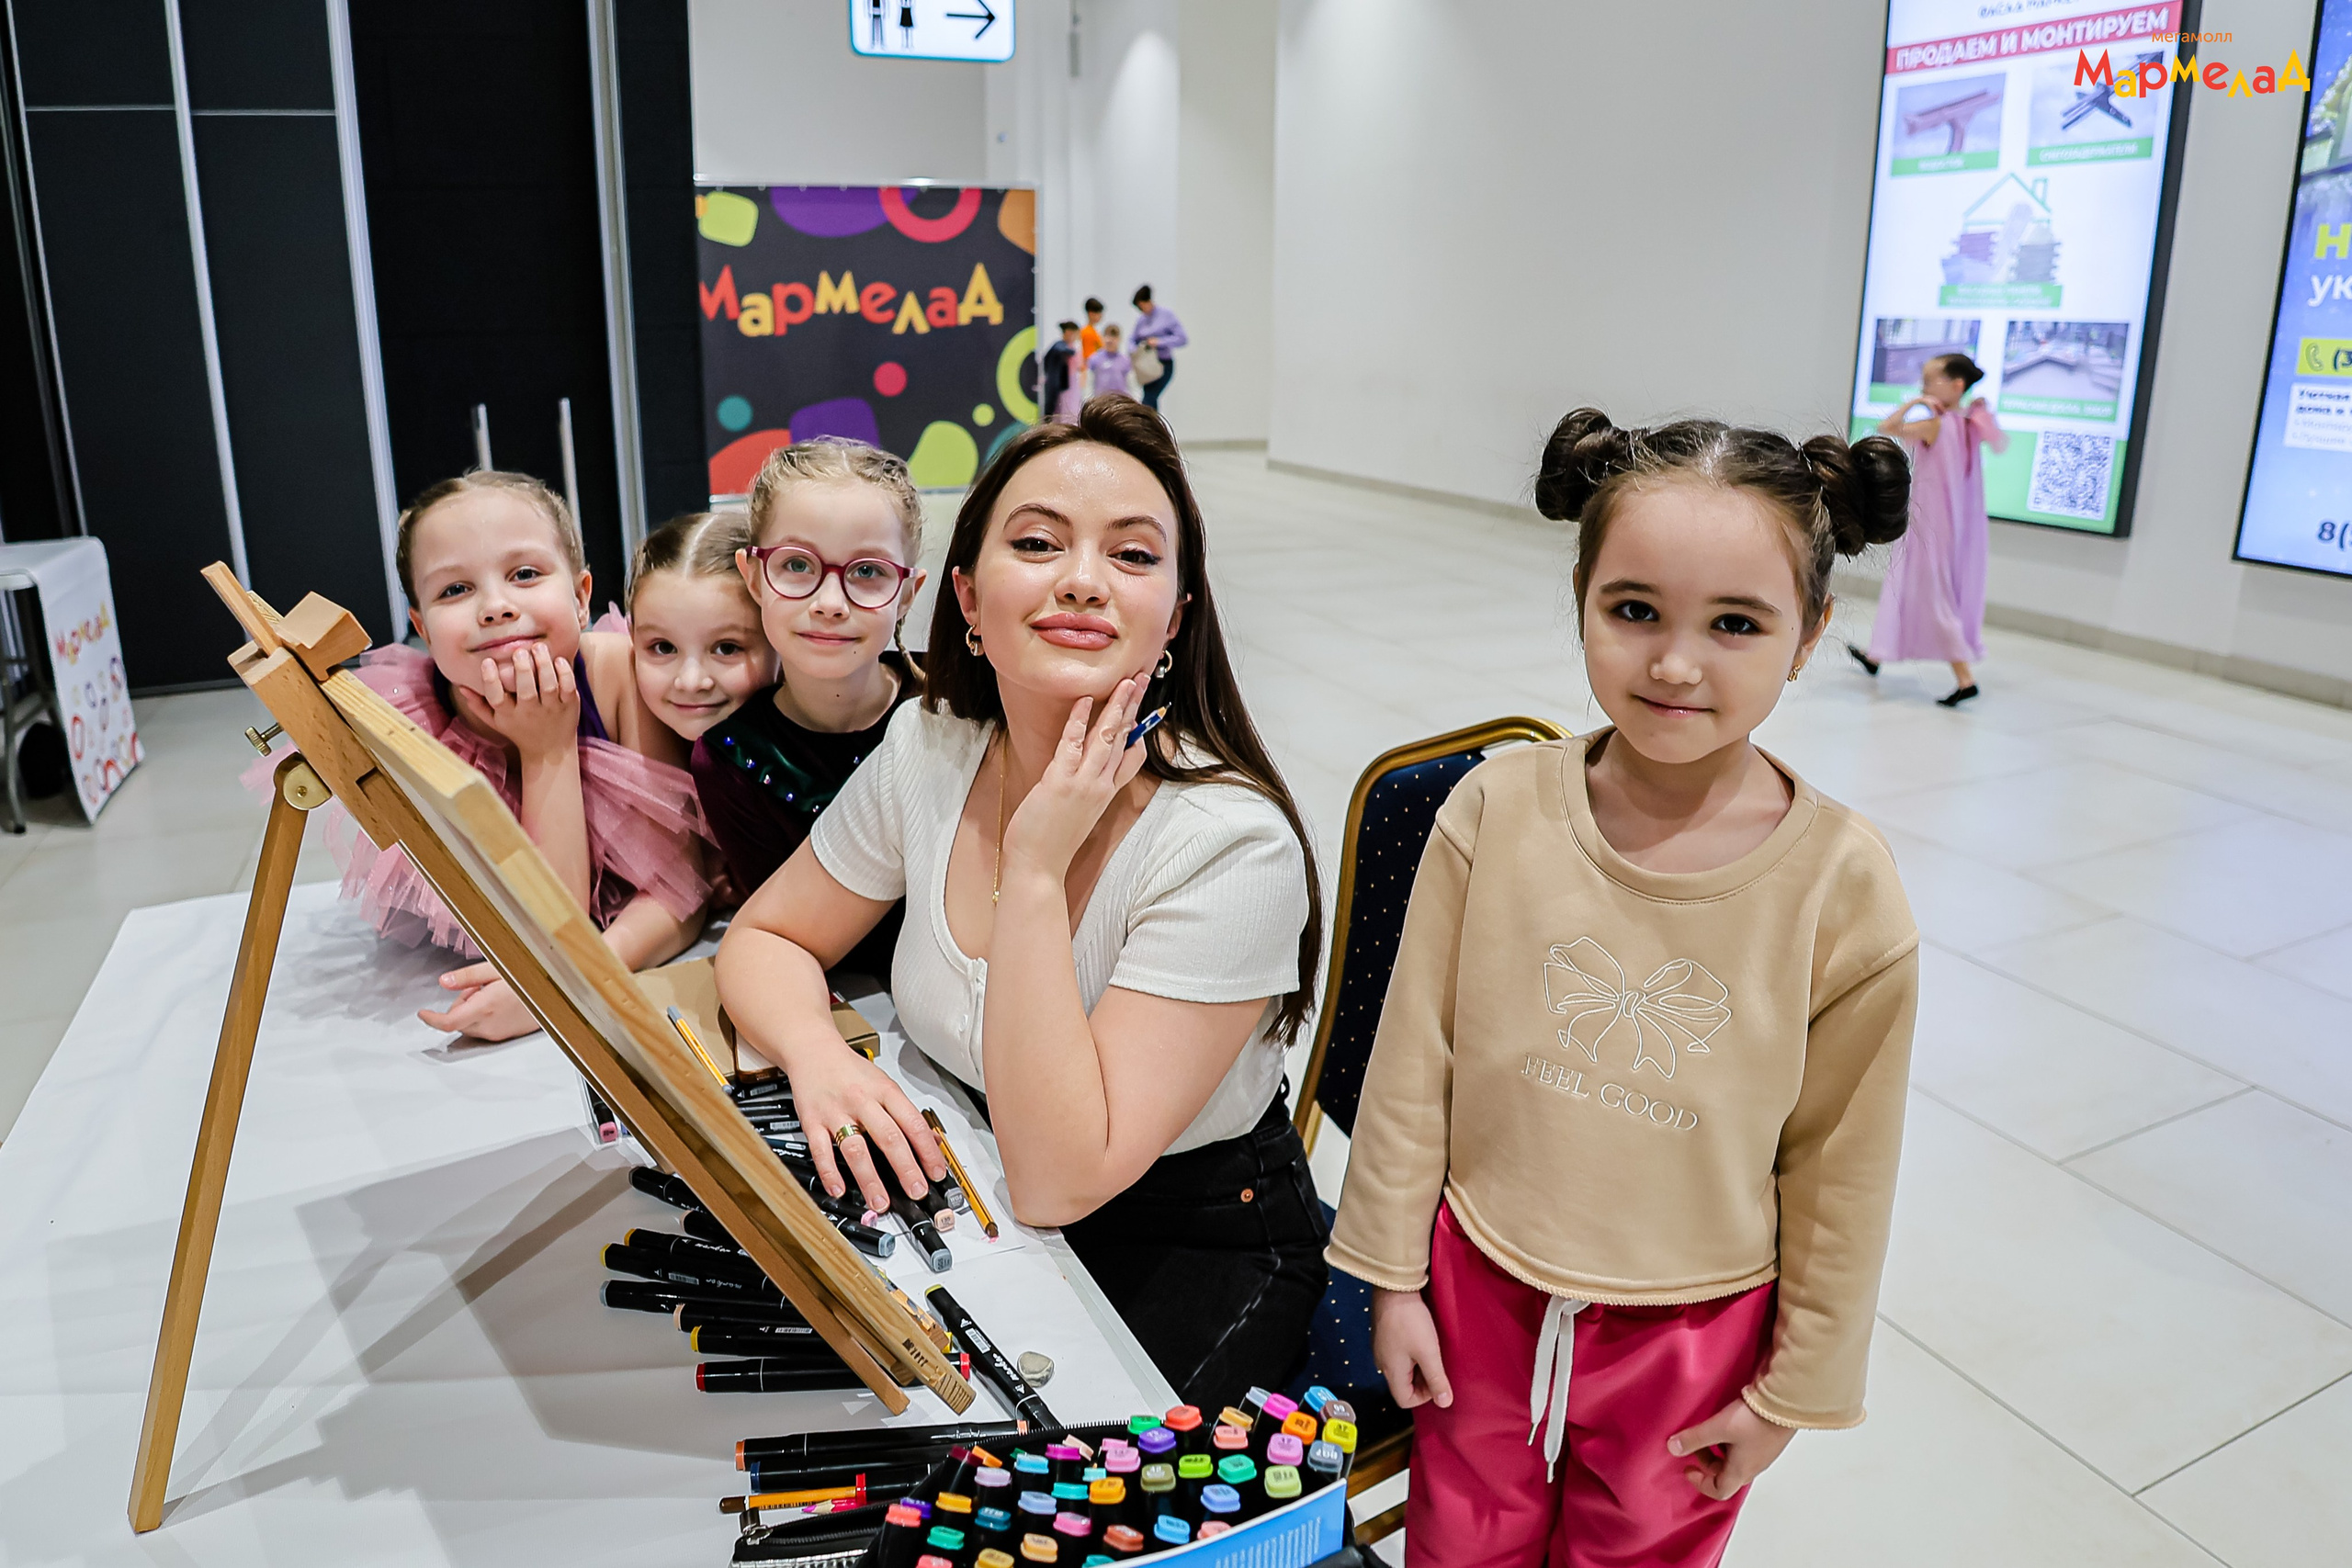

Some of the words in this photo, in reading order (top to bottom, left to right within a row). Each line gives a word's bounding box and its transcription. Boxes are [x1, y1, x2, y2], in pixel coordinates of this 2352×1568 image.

[1895, 35, 1996, 71] ПРОДАЕМ
[2000, 29, 2018, 54] И
[2021, 6, 2170, 53] МОНТИРУЕМ
[1521, 1053, 1590, 1098] FEEL
[1599, 1083, 1699, 1130] GOOD
